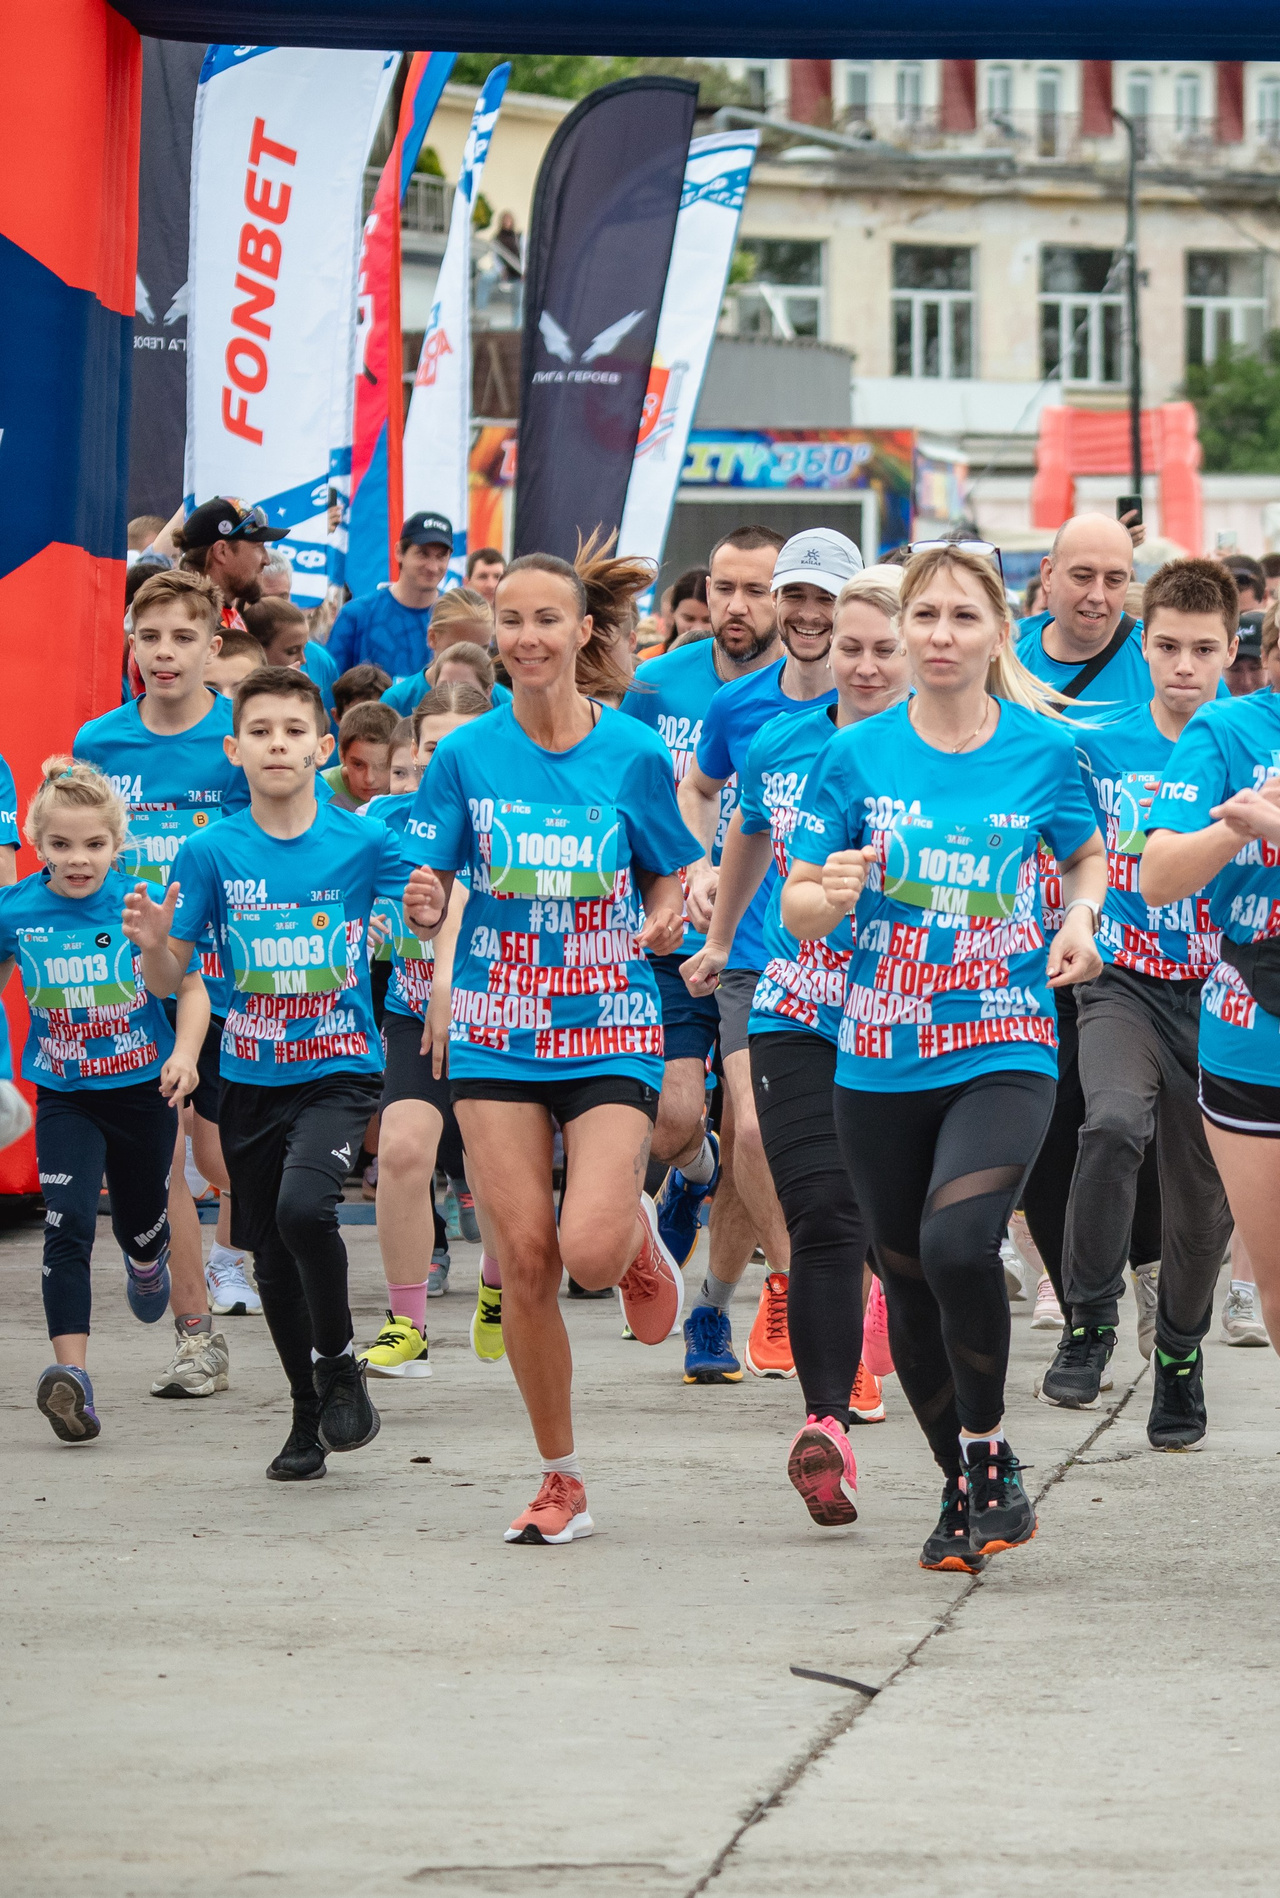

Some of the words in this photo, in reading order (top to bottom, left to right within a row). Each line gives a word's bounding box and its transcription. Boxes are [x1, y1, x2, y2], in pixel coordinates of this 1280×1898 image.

[221, 116, 297, 446] FONBET
[532, 371, 564, 384] ЛИГА
[566, 371, 621, 385] ГЕРОЕВ
[684, 443, 772, 482] ITY
[657, 714, 703, 751] 2024
[761, 772, 808, 807] 2024
[1138, 774, 1155, 782] ПСБ
[1162, 781, 1200, 803] ПСБ
[512, 805, 532, 815] ПСБ
[796, 810, 826, 834] ПСБ
[913, 817, 933, 829] ПСБ
[404, 818, 437, 840] ПСБ
[516, 832, 594, 868] 10094
[535, 869, 572, 897] 1KM
[918, 847, 991, 887] 10134
[1107, 851, 1139, 893] БЕГ
[223, 879, 268, 904] 2024
[931, 886, 970, 914] 1KM
[243, 913, 260, 921] ПСБ
[251, 935, 325, 968] 10003
[44, 953, 108, 985] 10013
[272, 970, 307, 994] 1KM
[487, 960, 630, 997] #ГОРДОСТЬ
[62, 985, 96, 1008] 1KM
[597, 991, 658, 1026] 2024
[980, 986, 1040, 1019] 2024
[314, 1008, 356, 1037] 2024
[838, 1016, 893, 1059] ЗАБЕГ
[38, 1035, 88, 1060] ЮБОВЬ
[113, 1026, 149, 1055] 2024
[274, 1031, 370, 1063] #ЕДИНСТВО
[535, 1024, 665, 1059] #ЕДИНСТВ
